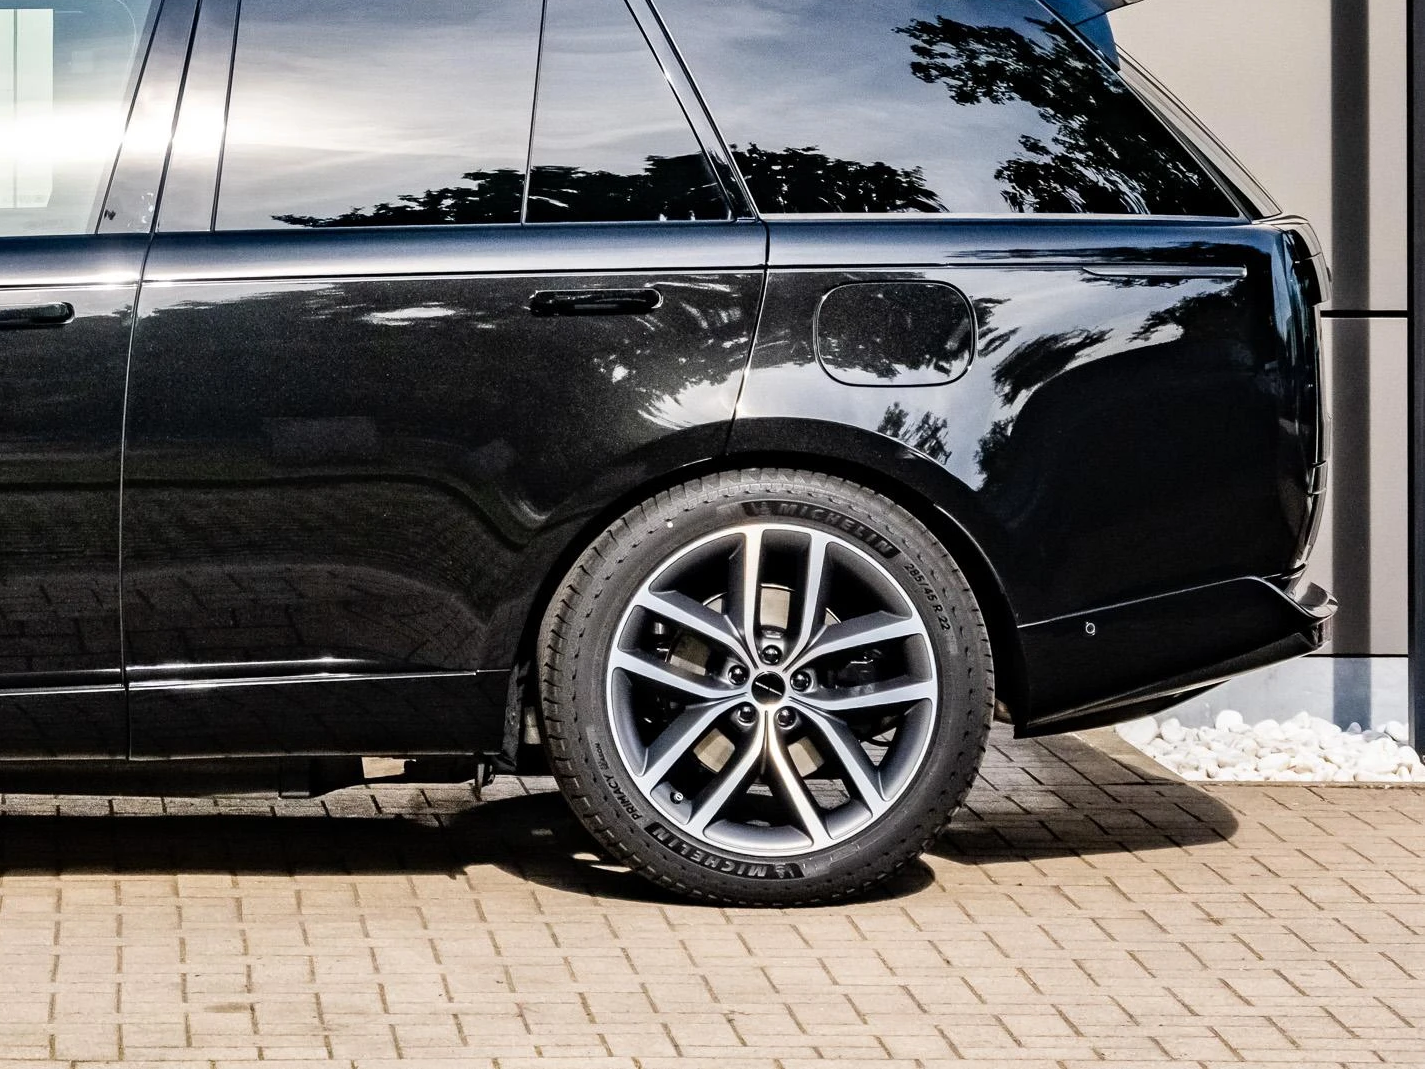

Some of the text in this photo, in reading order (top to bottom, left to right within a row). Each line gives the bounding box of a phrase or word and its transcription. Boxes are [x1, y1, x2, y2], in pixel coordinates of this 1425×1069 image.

[778, 502, 896, 557] MICHELIN
[904, 563, 951, 631] 285/45 R 22
[603, 774, 643, 821] PRIMACY
[651, 826, 768, 878] MICHELIN
